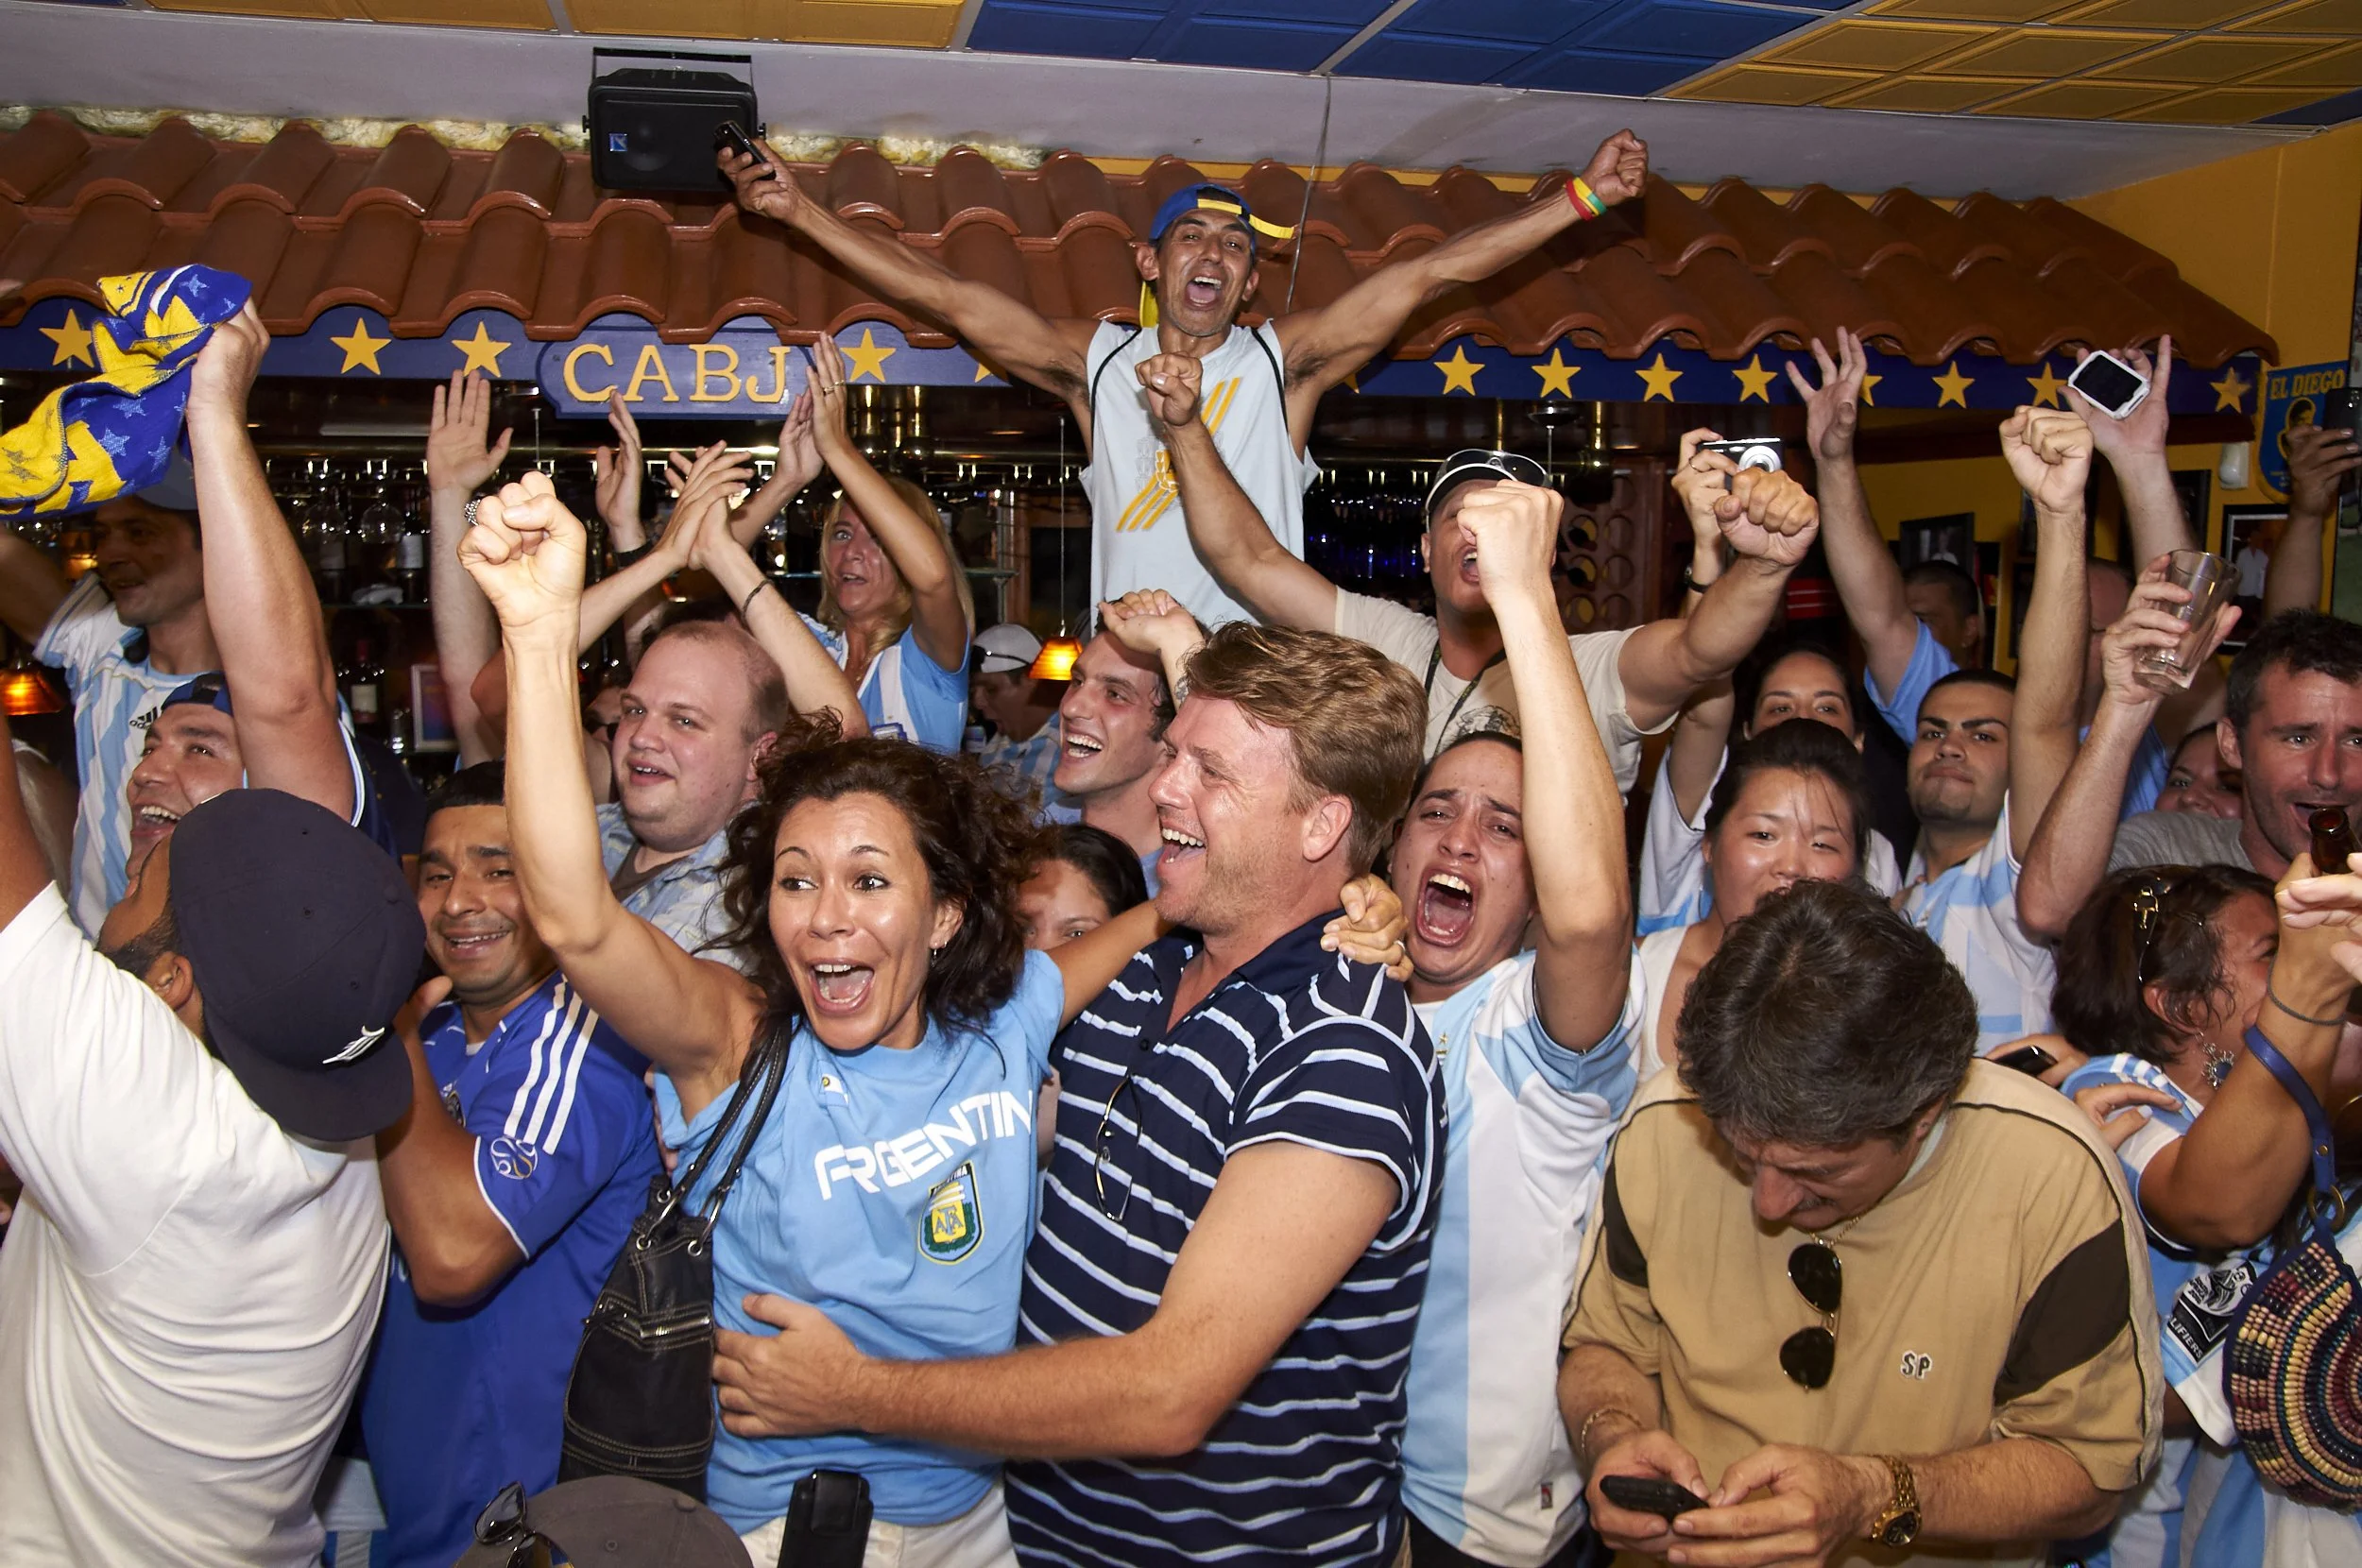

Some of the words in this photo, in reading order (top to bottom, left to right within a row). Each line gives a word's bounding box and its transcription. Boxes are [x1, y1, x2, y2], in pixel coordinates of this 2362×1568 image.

[563, 343, 792, 403] CABJ
[2269, 377, 2290, 401] EL
[2290, 369, 2346, 398] DIEGO
[1900, 1350, 1933, 1380] SP
